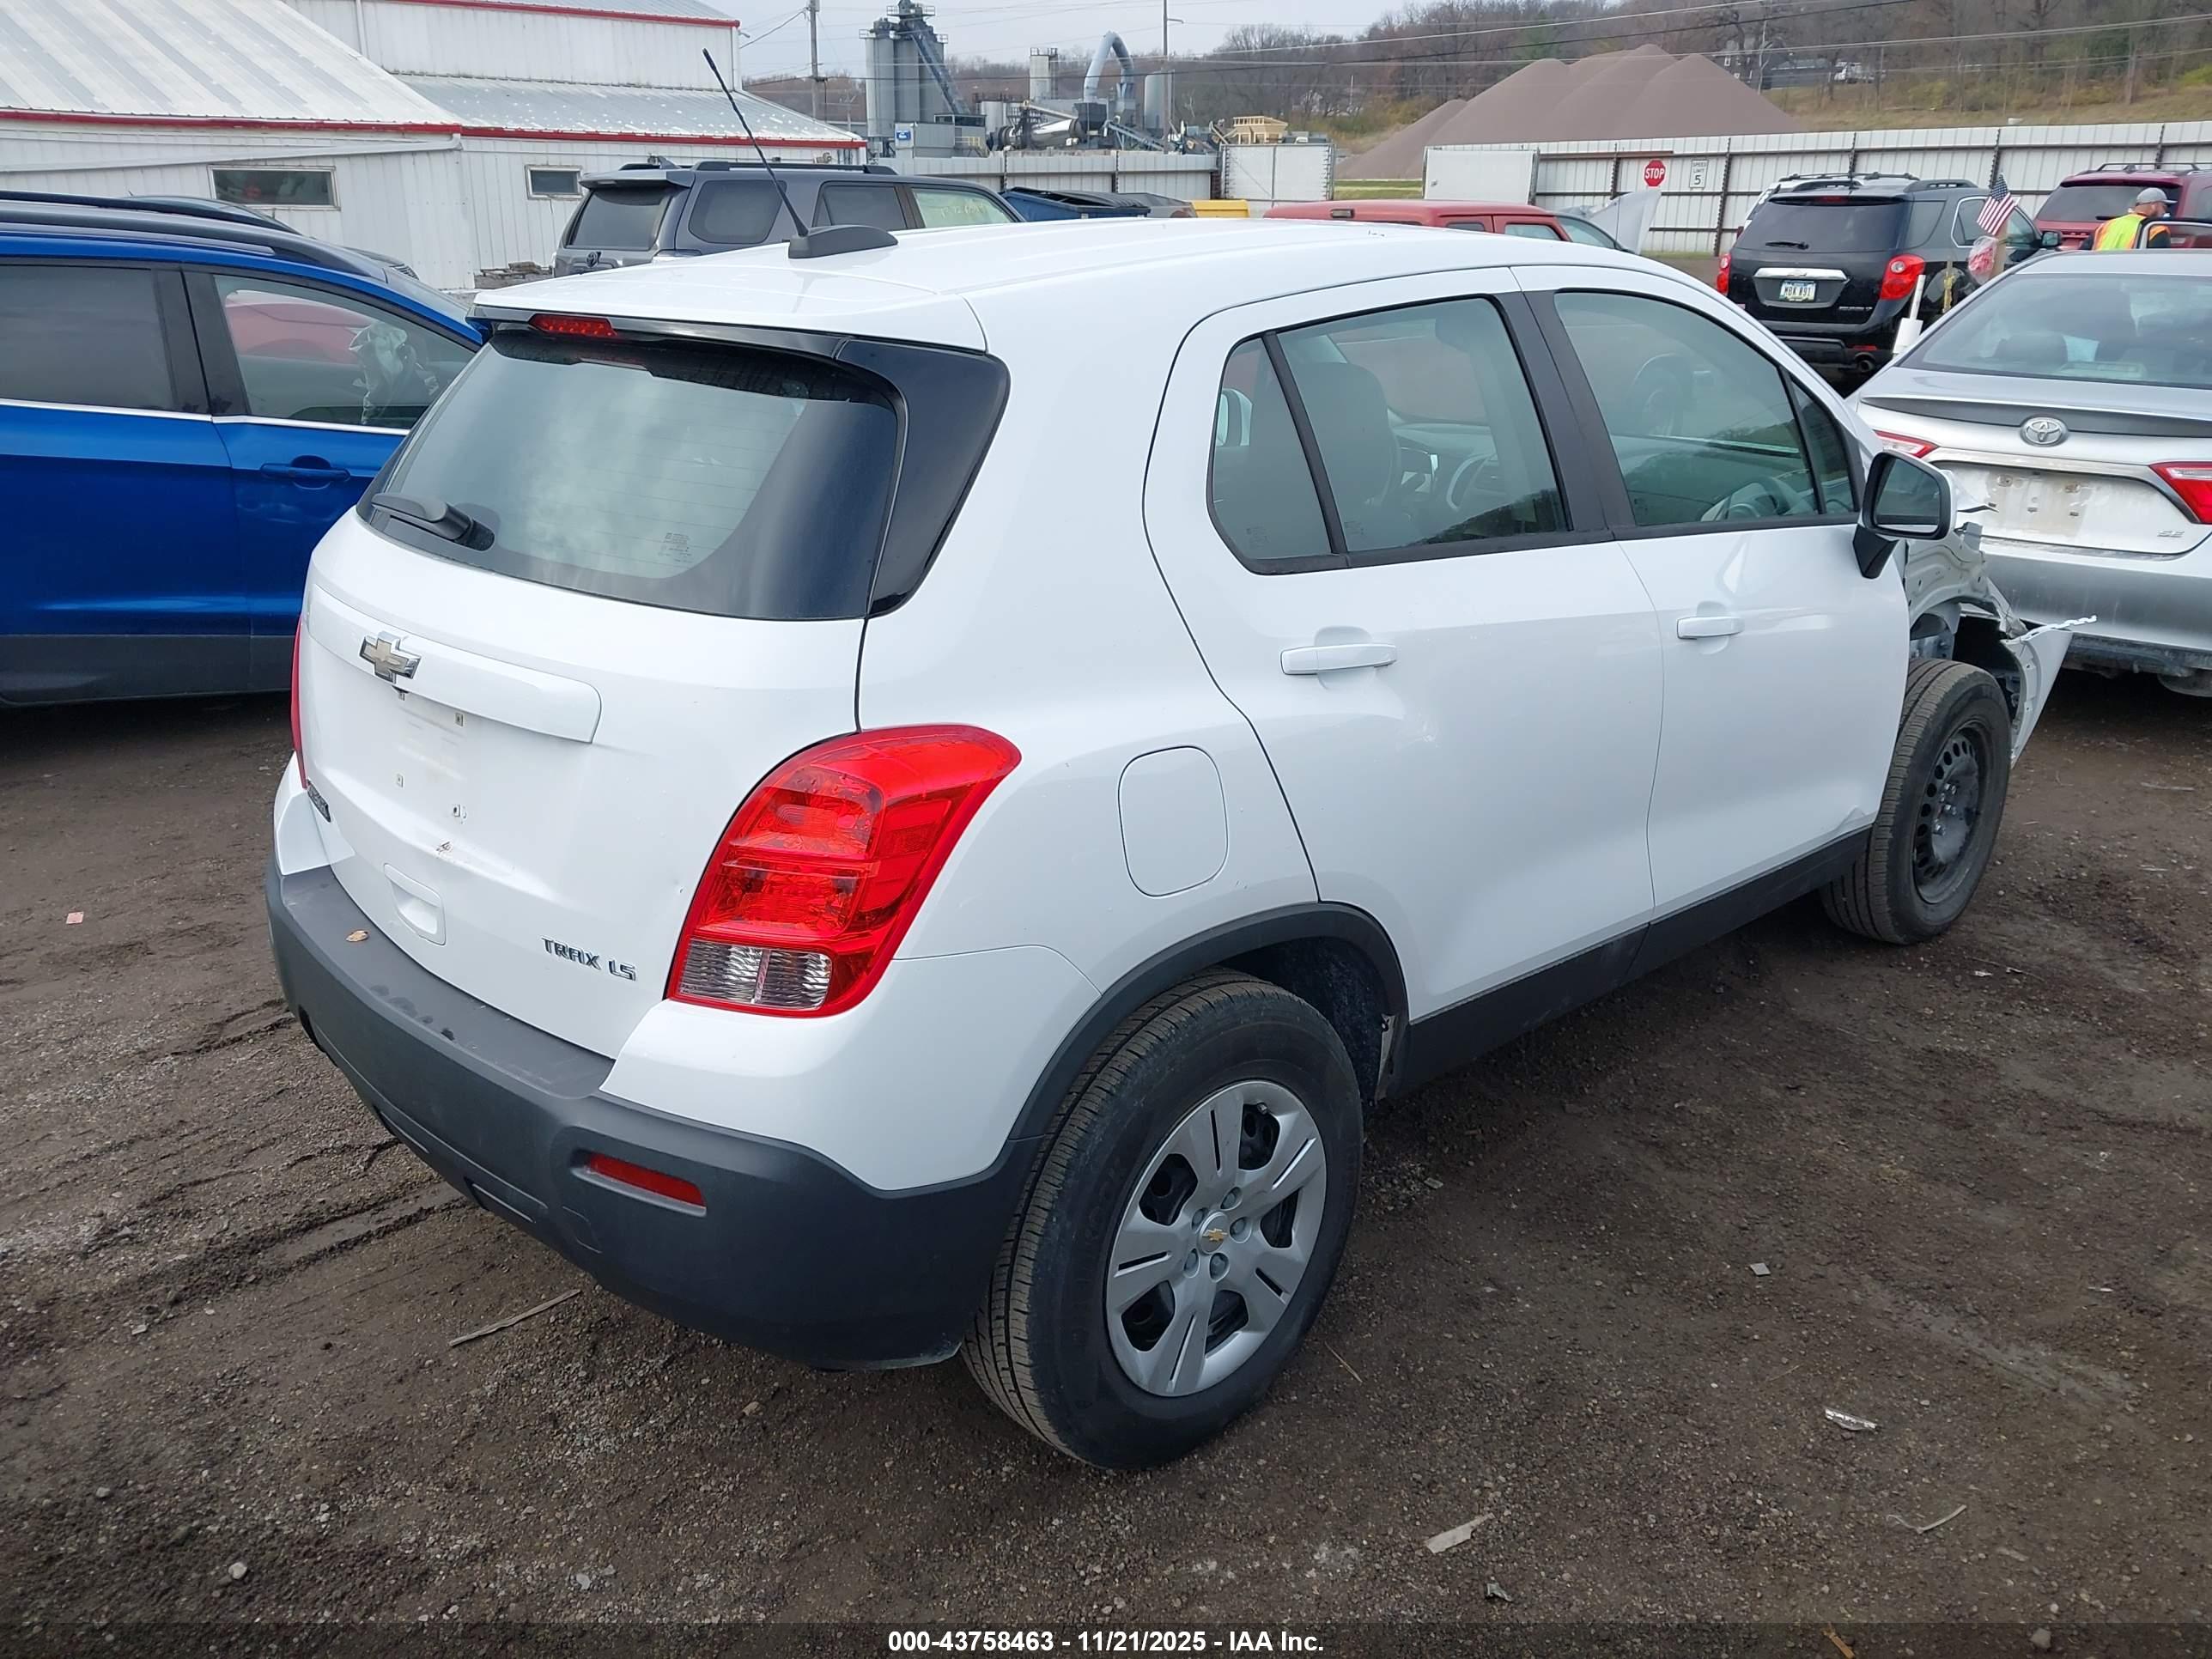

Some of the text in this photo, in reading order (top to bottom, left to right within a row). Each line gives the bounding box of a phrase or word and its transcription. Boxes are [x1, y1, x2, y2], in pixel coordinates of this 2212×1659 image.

[1645, 167, 1665, 179] STOP
[1694, 174, 1702, 185] 5
[541, 936, 636, 981] TRAX LS
